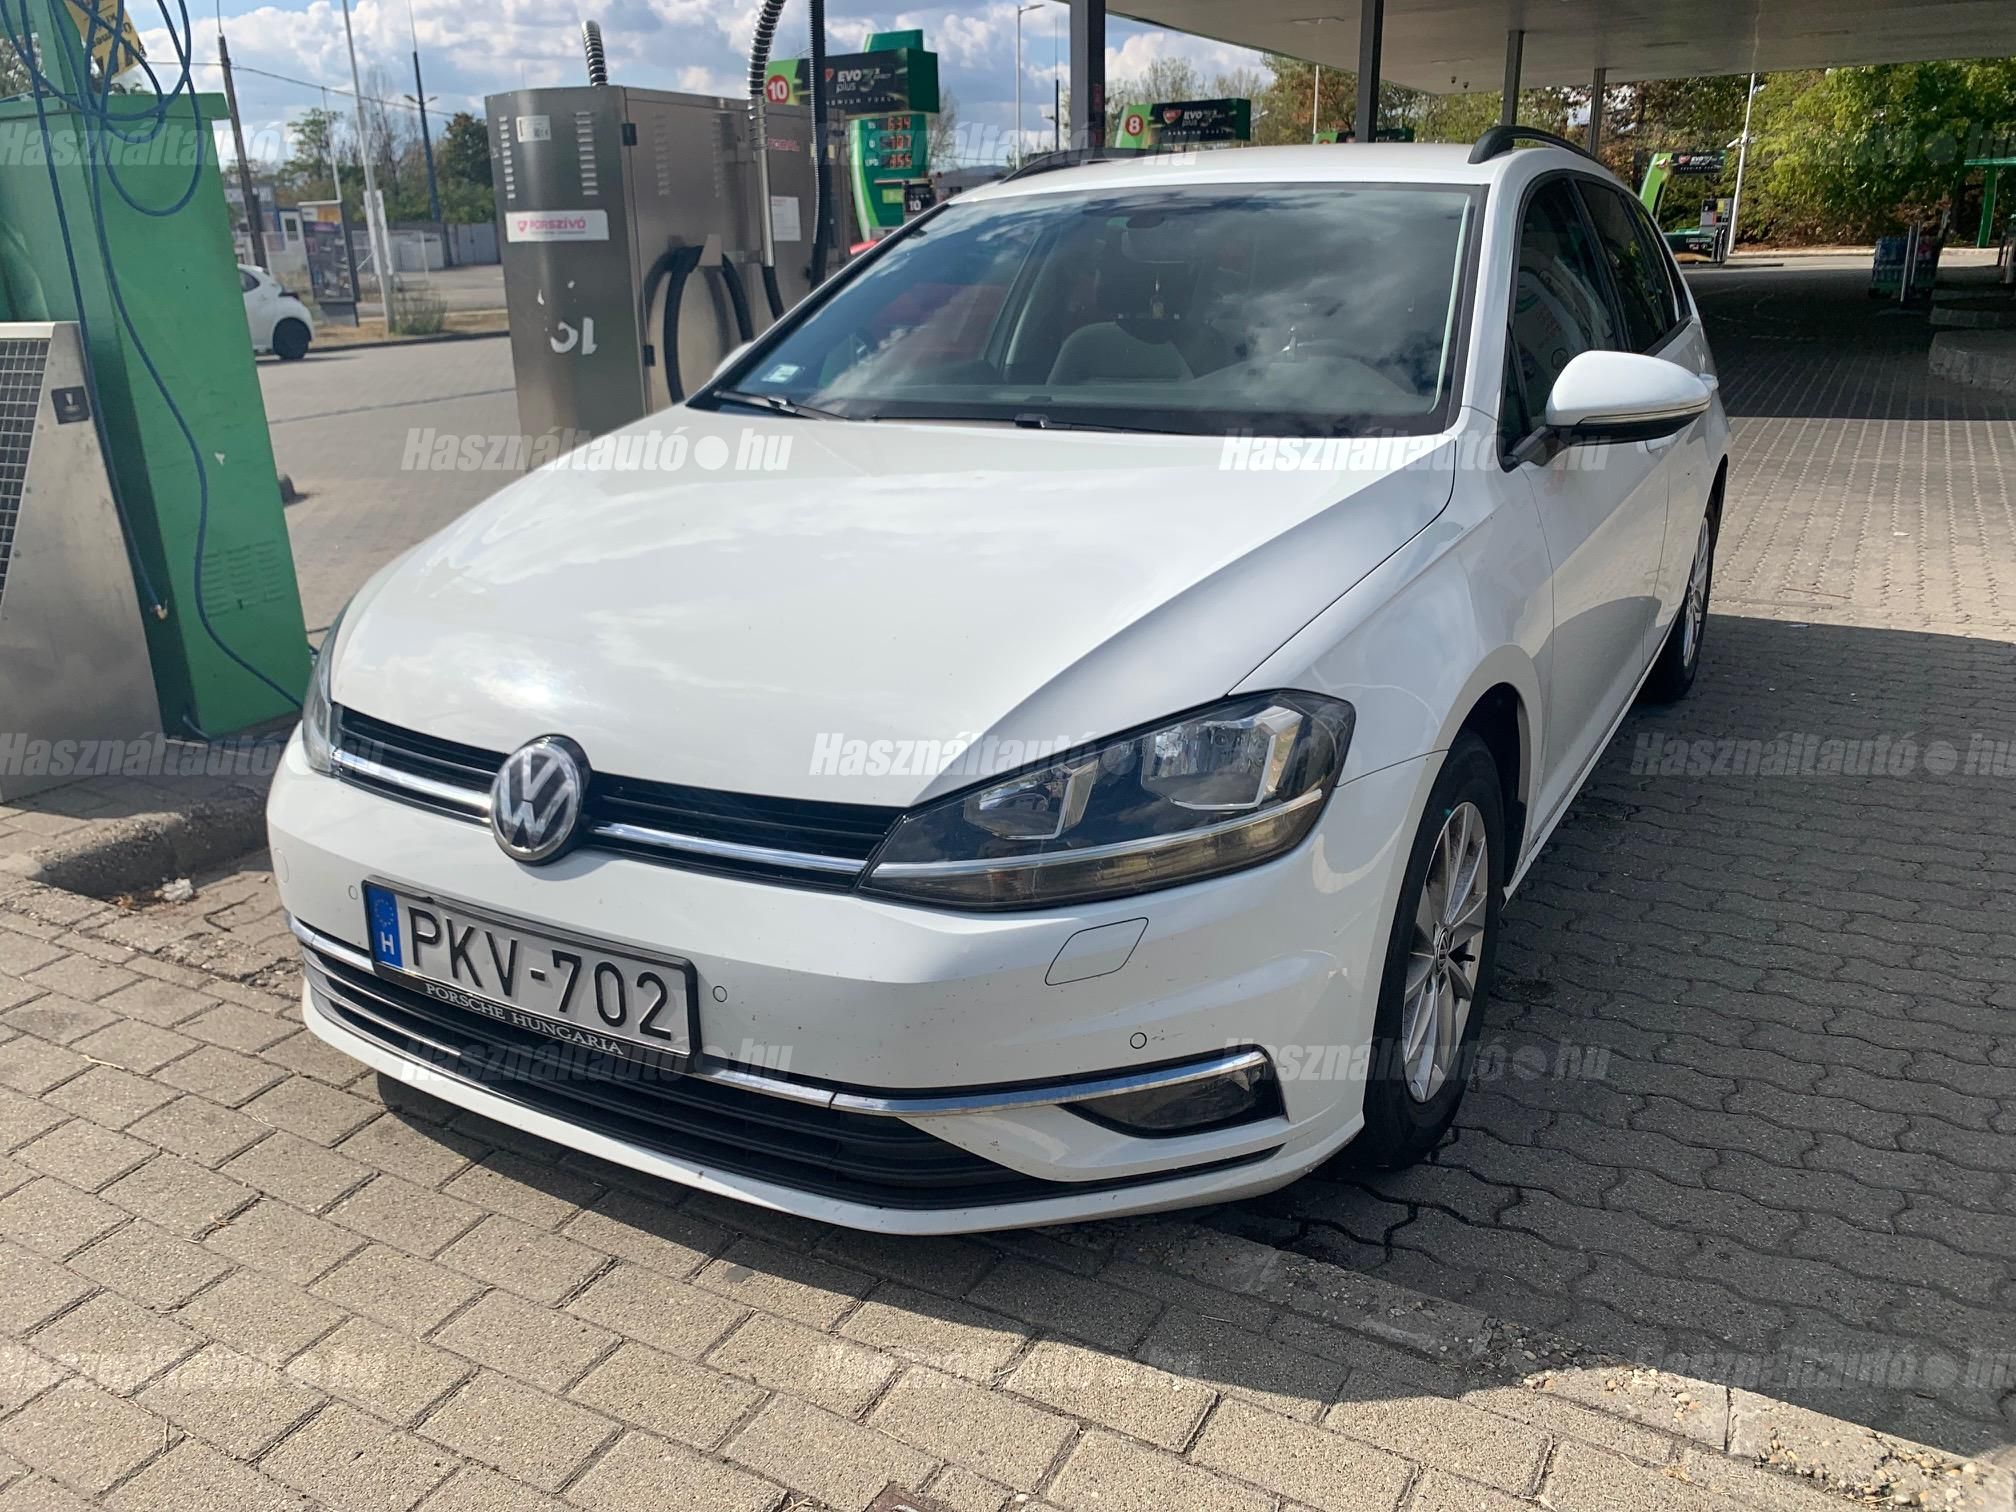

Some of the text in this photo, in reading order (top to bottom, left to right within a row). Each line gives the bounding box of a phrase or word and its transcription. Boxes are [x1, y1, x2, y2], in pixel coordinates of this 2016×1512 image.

[838, 69, 861, 82] EVO
[768, 81, 788, 100] 10
[1129, 117, 1141, 135] 8
[909, 200, 921, 211] 10
[382, 906, 672, 1041] H PKV-702
[425, 983, 624, 1055] PORSCHE HUNGARIA
